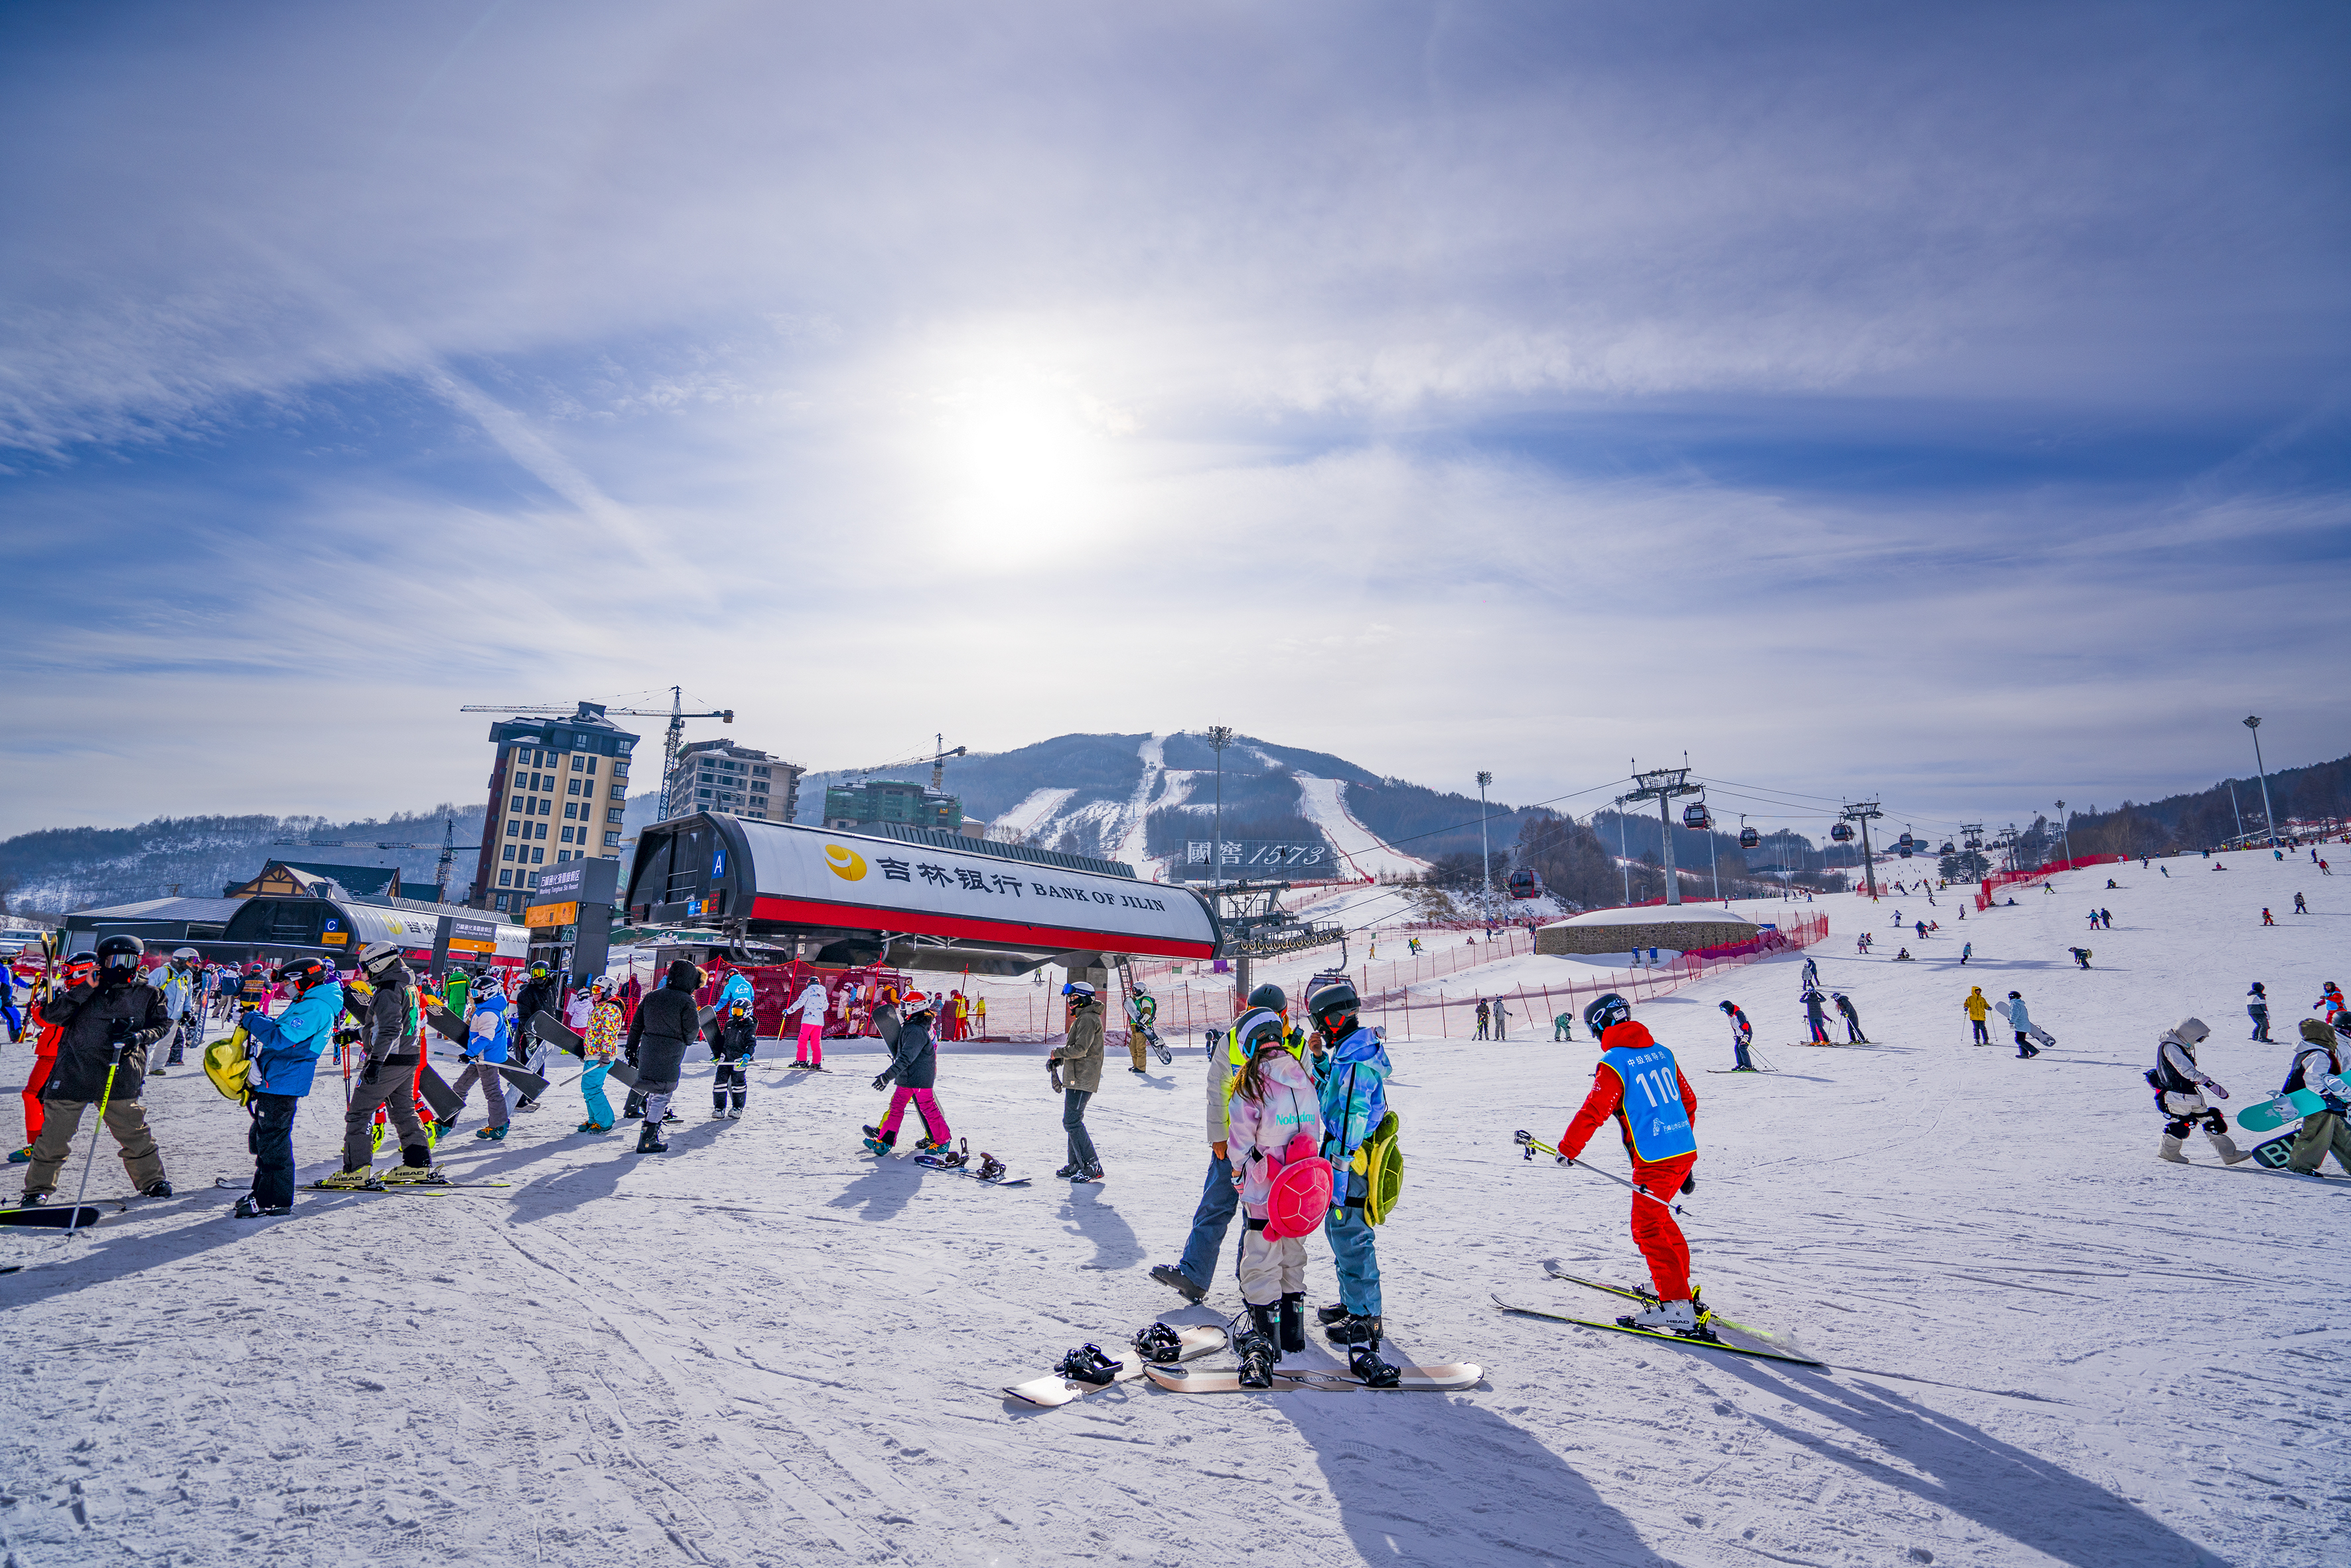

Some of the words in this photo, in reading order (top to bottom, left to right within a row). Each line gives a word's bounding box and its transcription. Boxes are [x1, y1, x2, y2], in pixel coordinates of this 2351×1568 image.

[714, 855, 722, 874] A
[875, 856, 1023, 898] 吉林银行
[1031, 883, 1090, 902] BANK
[1092, 891, 1115, 905] OF
[1120, 895, 1166, 912] JILIN
[327, 920, 336, 930] C
[1627, 1051, 1666, 1067] 中级指导员
[1635, 1067, 1679, 1107] 110
